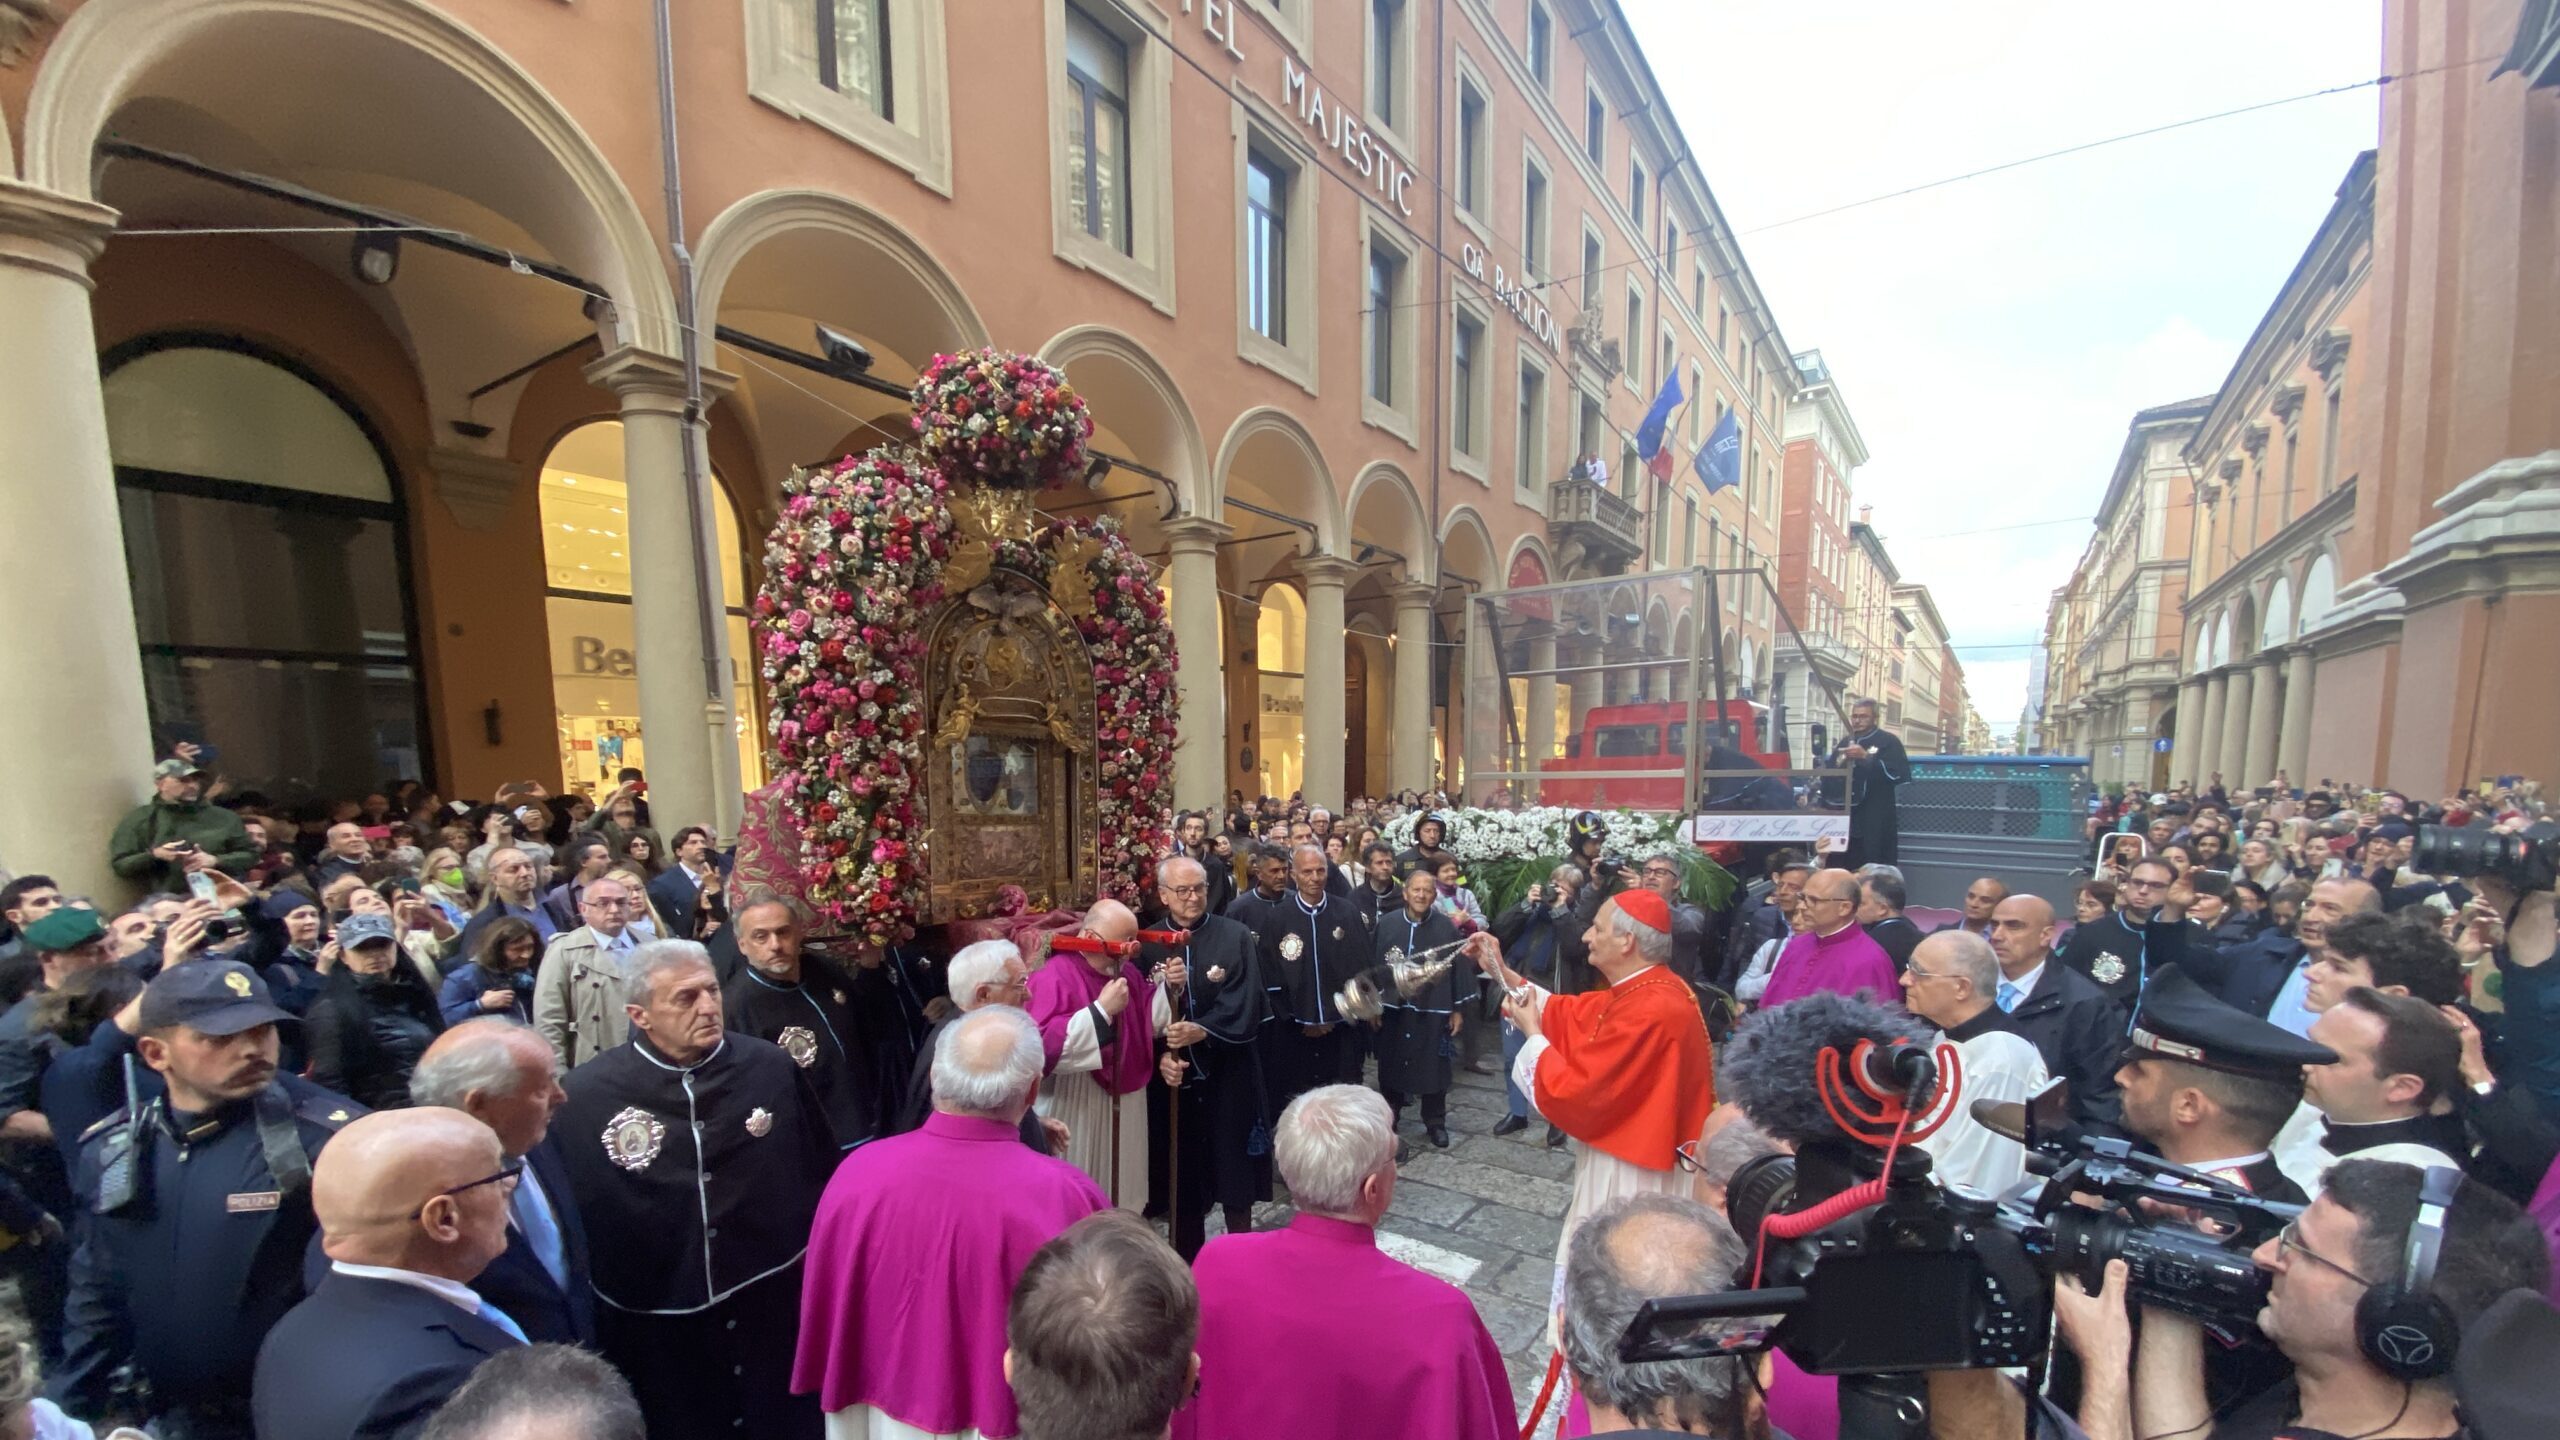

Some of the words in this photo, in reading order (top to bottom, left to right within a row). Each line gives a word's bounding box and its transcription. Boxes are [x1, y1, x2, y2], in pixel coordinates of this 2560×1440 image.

[1282, 55, 1412, 217] MAJESTIC
[1496, 264, 1562, 354] BAGLIONI
[573, 635, 638, 678] Be
[1749, 824, 1767, 837] di
[1768, 818, 1801, 837] San
[2214, 1264, 2244, 1275] SONY
